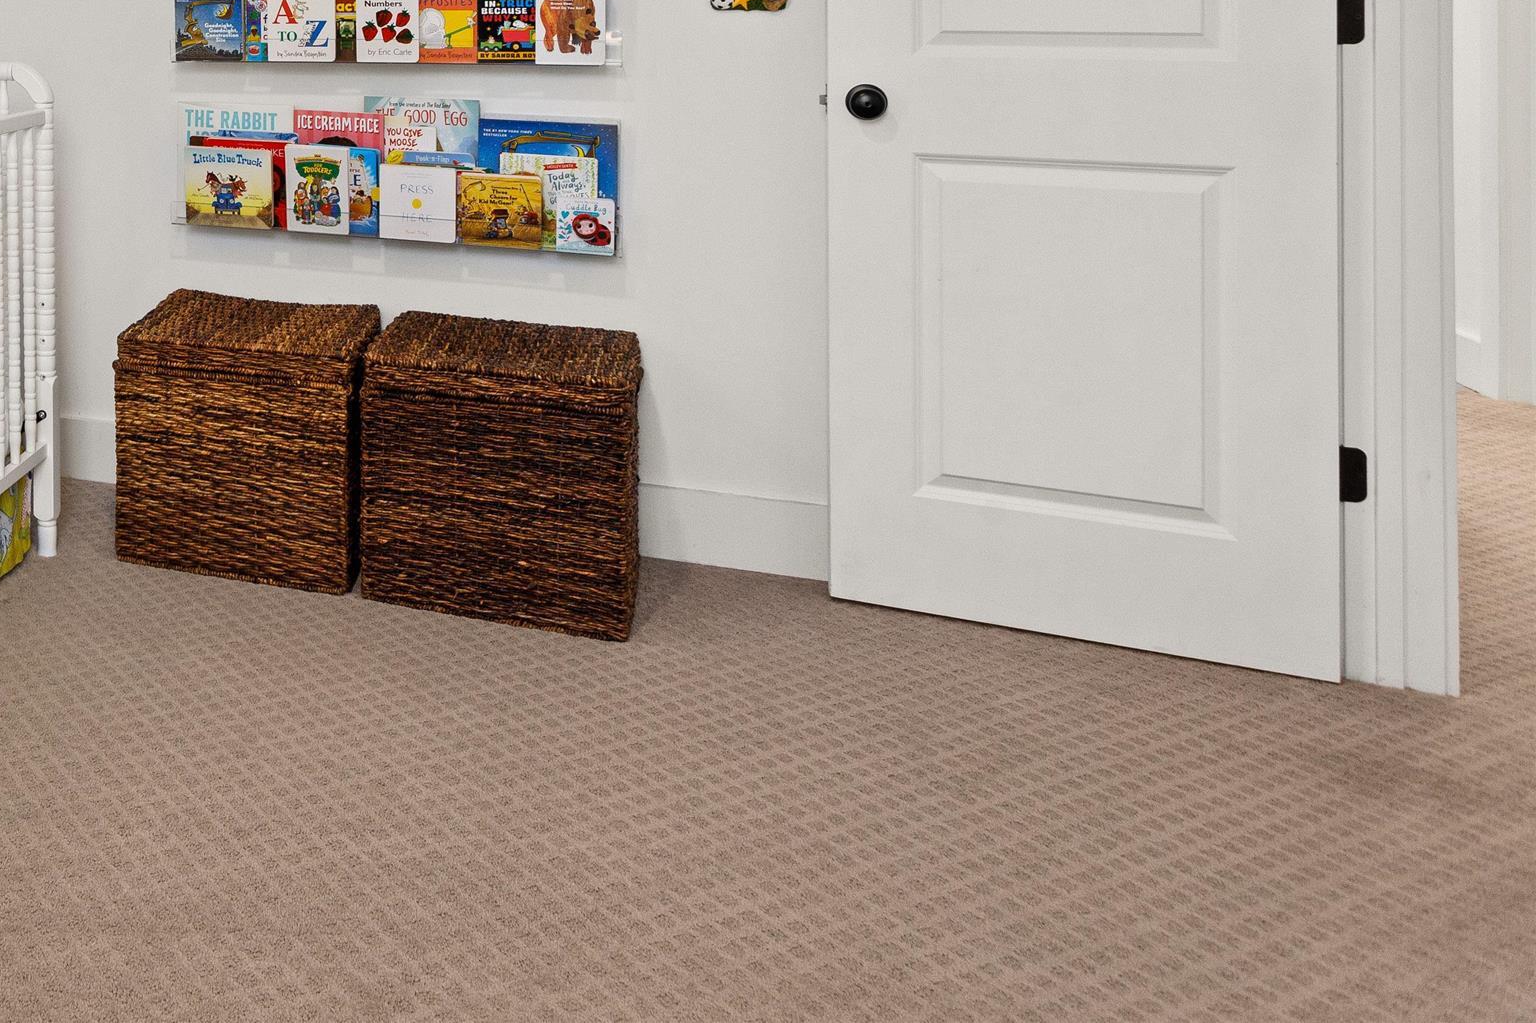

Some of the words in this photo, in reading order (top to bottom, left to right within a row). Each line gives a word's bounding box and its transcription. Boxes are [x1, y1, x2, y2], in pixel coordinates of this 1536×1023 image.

[499, 0, 535, 8] TRUC
[481, 7, 528, 15] BECAUSE
[483, 15, 510, 23] WHY
[520, 15, 536, 23] NO
[277, 31, 298, 42] TO
[303, 20, 329, 48] Z
[392, 48, 413, 56] Carle
[185, 109, 214, 128] THE
[220, 111, 278, 130] RABBIT
[404, 109, 437, 124] GOOD
[444, 110, 469, 126] EGG
[297, 115, 312, 130] ICE
[314, 115, 353, 132] CREAM
[354, 118, 380, 134] FACE
[386, 128, 401, 137] YOU
[403, 128, 424, 137] GIVE
[389, 138, 418, 147] MOOSE
[192, 153, 216, 164] Little
[216, 153, 235, 163] Blue
[236, 154, 263, 167] Truck
[303, 166, 333, 175] TODDLERS
[547, 171, 579, 184] Today
[400, 184, 434, 195] PRESS
[401, 212, 433, 223] HERE
